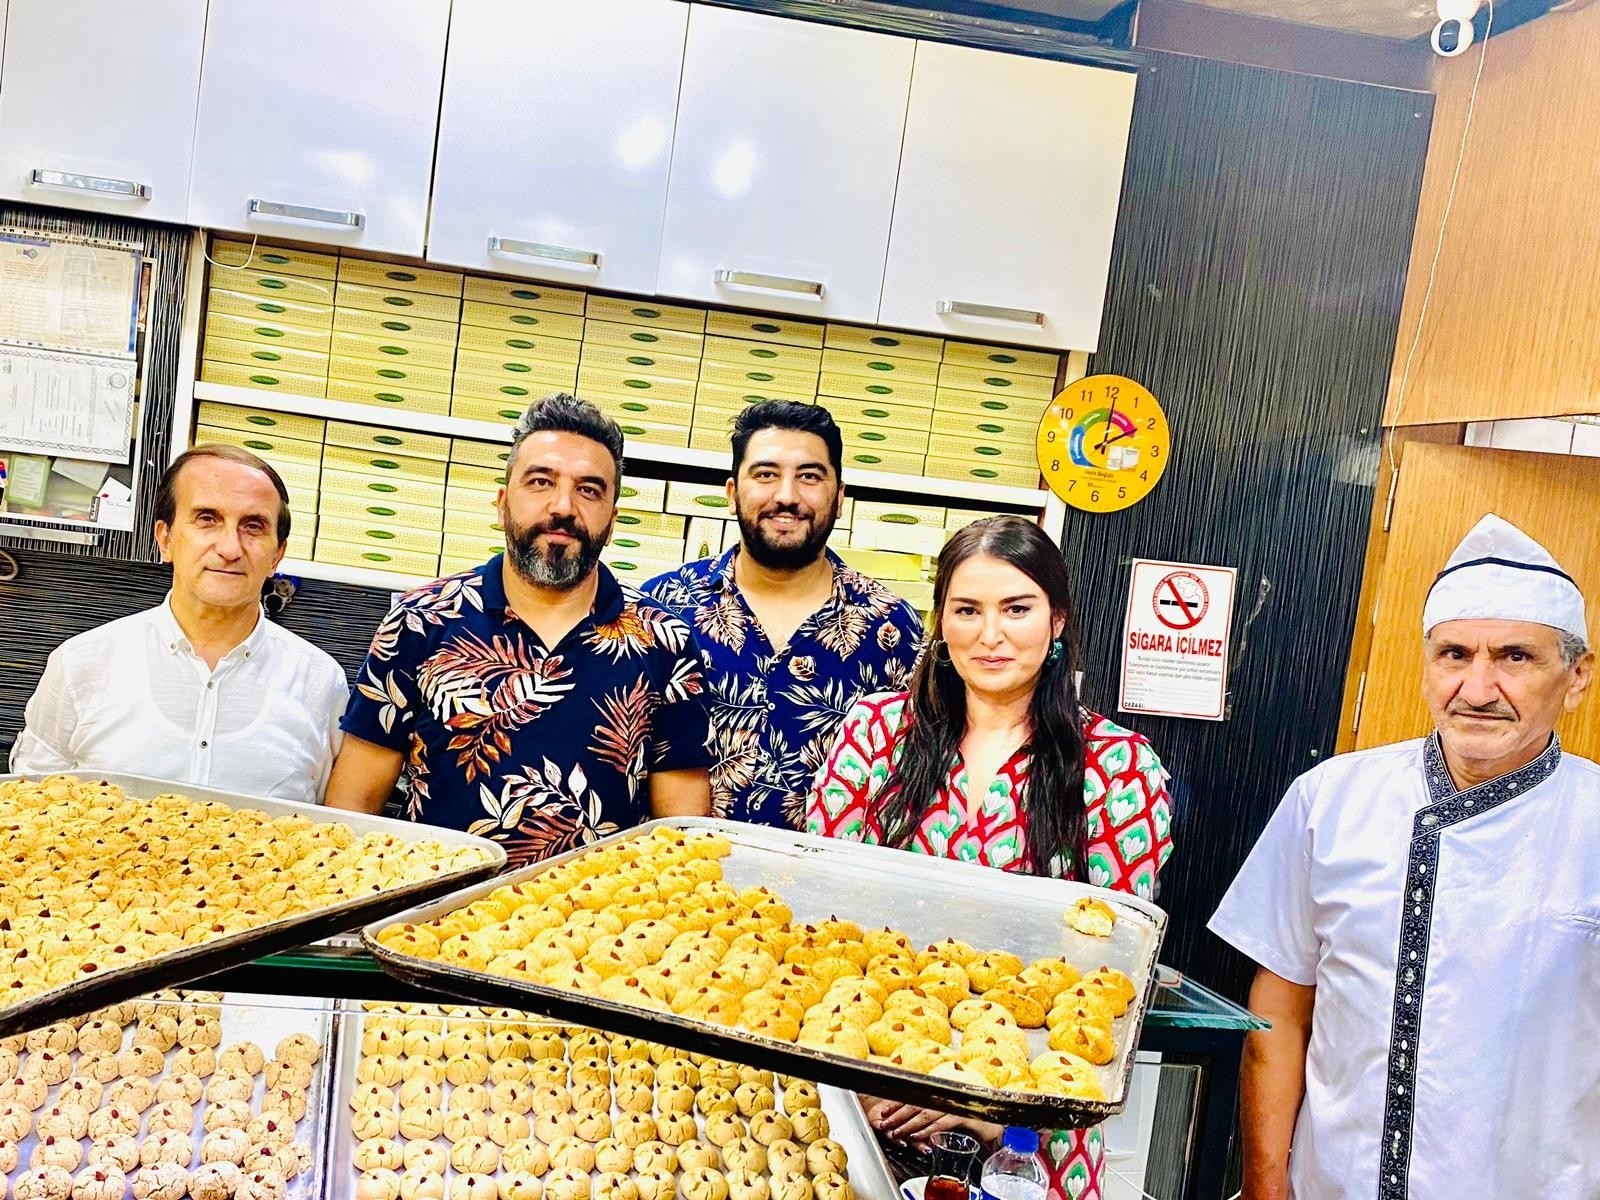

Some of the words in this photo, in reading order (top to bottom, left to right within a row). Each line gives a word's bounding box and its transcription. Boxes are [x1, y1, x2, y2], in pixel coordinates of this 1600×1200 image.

[1081, 390, 1093, 402] 11
[1105, 386, 1120, 399] 12
[1133, 397, 1139, 408] 1
[1060, 408, 1073, 420] 10
[1147, 418, 1156, 430] 2
[1047, 431, 1056, 442] 9
[1151, 446, 1159, 457] 3
[1051, 460, 1060, 472] 8
[1140, 470, 1147, 482] 4
[1068, 480, 1077, 492] 7
[1091, 491, 1100, 502] 6
[1118, 487, 1126, 498] 5
[1129, 628, 1172, 653] SİGARA
[1176, 632, 1222, 659] İÇİLMEZ
